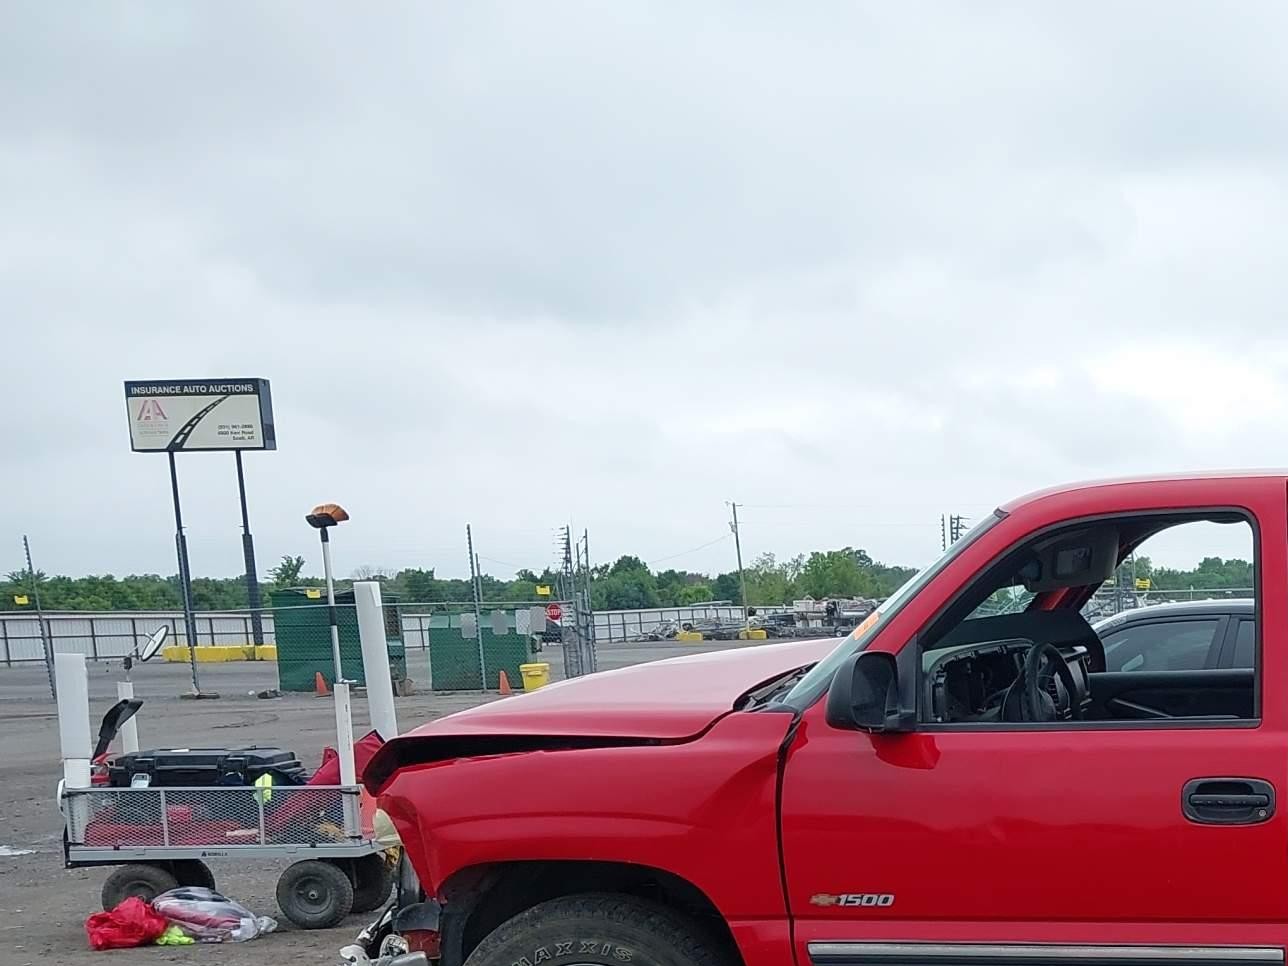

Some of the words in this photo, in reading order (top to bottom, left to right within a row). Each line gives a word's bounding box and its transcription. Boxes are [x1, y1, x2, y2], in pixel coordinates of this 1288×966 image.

[131, 385, 181, 395] INSURANCE
[183, 384, 207, 394] AUTO
[209, 383, 254, 393] AUCTIONS
[547, 608, 561, 616] STOP
[838, 893, 895, 907] 1500
